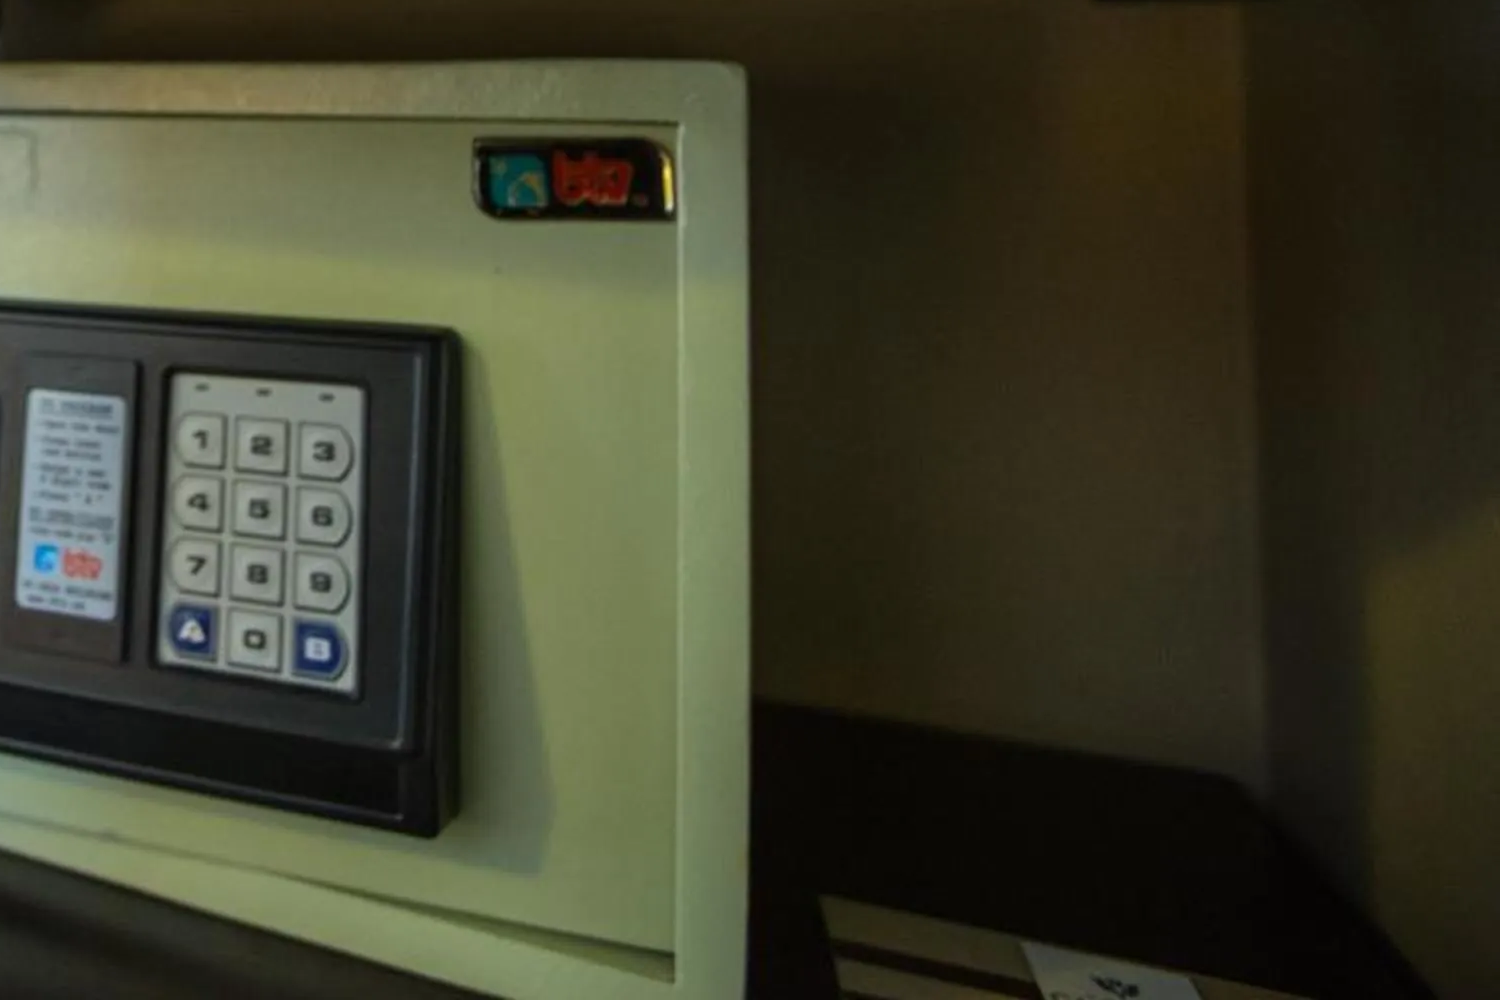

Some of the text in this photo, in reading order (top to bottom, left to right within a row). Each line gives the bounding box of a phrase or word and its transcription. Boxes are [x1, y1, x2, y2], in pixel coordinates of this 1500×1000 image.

[191, 430, 336, 463] 1 2 3
[187, 493, 334, 528] 4 5 6
[185, 555, 333, 594] 7 8 9
[177, 618, 332, 663] A 0 B
